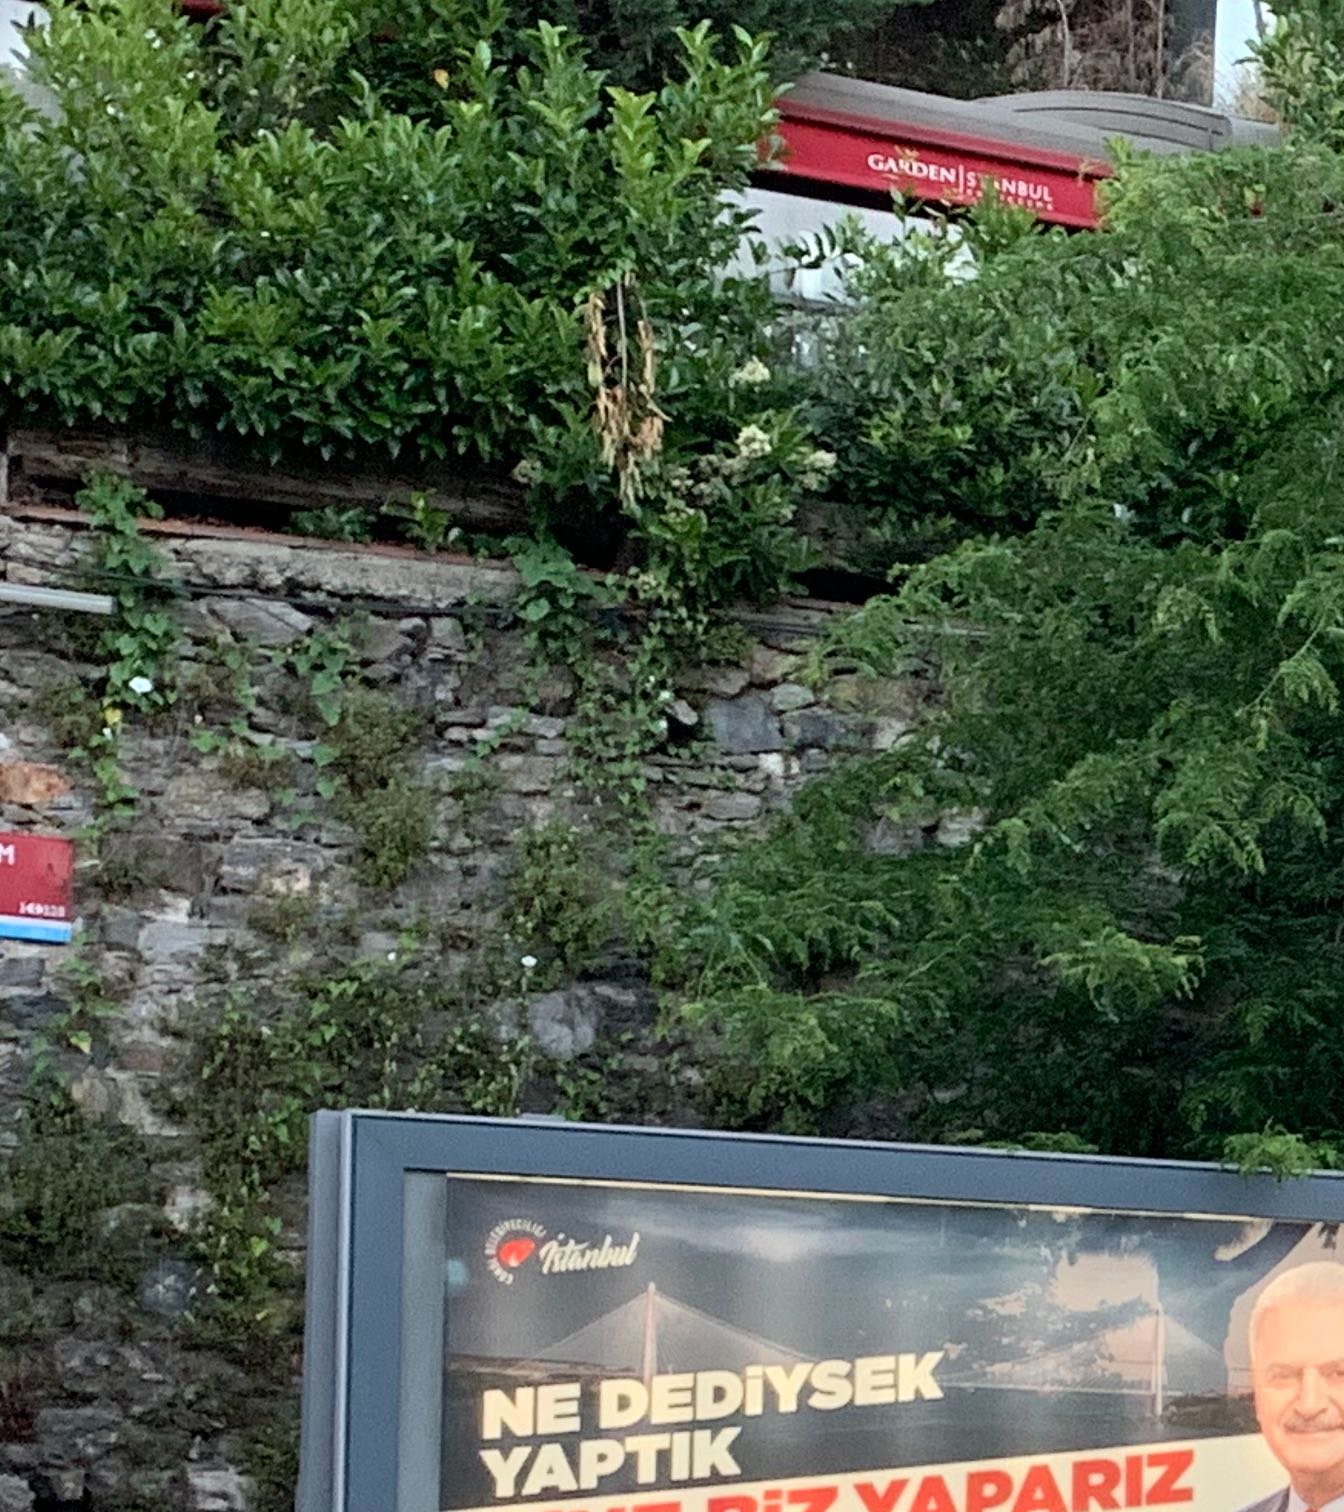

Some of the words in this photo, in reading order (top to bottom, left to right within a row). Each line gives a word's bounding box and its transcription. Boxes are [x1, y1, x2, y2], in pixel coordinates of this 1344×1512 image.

[539, 1231, 641, 1275] İstanbul
[482, 1383, 582, 1440] NE
[600, 1351, 949, 1430] DEDİYSEK
[480, 1427, 742, 1498] YAPTIK
